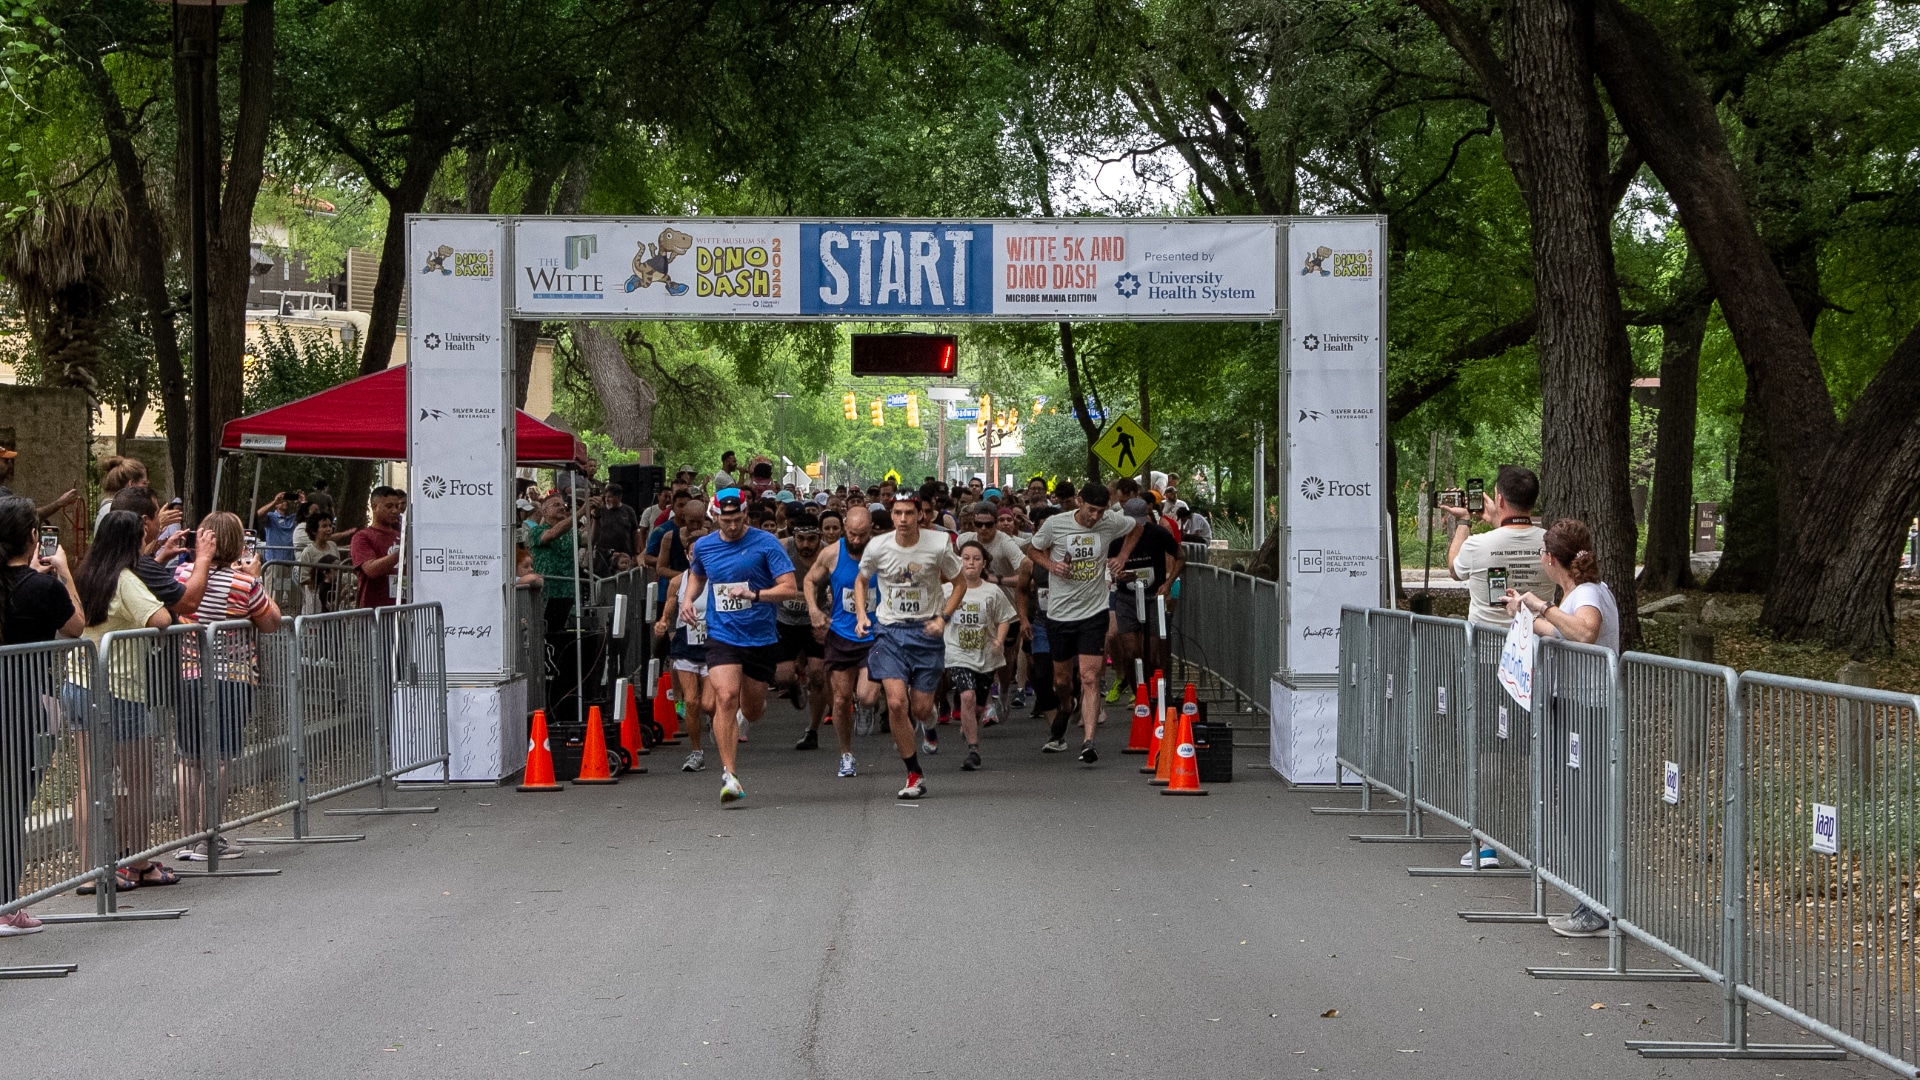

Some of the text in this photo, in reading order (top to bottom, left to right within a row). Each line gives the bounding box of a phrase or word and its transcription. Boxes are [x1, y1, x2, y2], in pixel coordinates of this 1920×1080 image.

[1006, 236, 1125, 261] WITTE 5K AND
[538, 258, 559, 267] THE
[1144, 252, 1215, 262] Presented by
[455, 264, 489, 276] DASH
[772, 238, 782, 298] 2022
[819, 230, 974, 306] START
[1334, 264, 1367, 277] DASH
[1006, 264, 1097, 289] DINO DASH
[1148, 270, 1223, 287] University
[696, 268, 770, 297] DASH
[1005, 294, 1097, 302] MICROBE MANIA EDITION
[1148, 286, 1256, 302] Health System
[445, 333, 491, 344] University
[1323, 333, 1369, 344] University
[445, 342, 475, 350] Health
[1323, 343, 1353, 351] Health
[449, 479, 494, 496] Frost
[1327, 480, 1372, 497] Frost
[1075, 547, 1094, 558] 364
[425, 555, 445, 565] BIG
[1303, 557, 1322, 566] BIG
[1072, 570, 1095, 581] ASH
[721, 599, 743, 611] 326
[789, 601, 807, 611] 366
[849, 603, 869, 612] 32
[900, 602, 920, 612] 429
[960, 614, 979, 624] 365
[476, 625, 492, 639] SA
[1815, 805, 1835, 843] iaap
